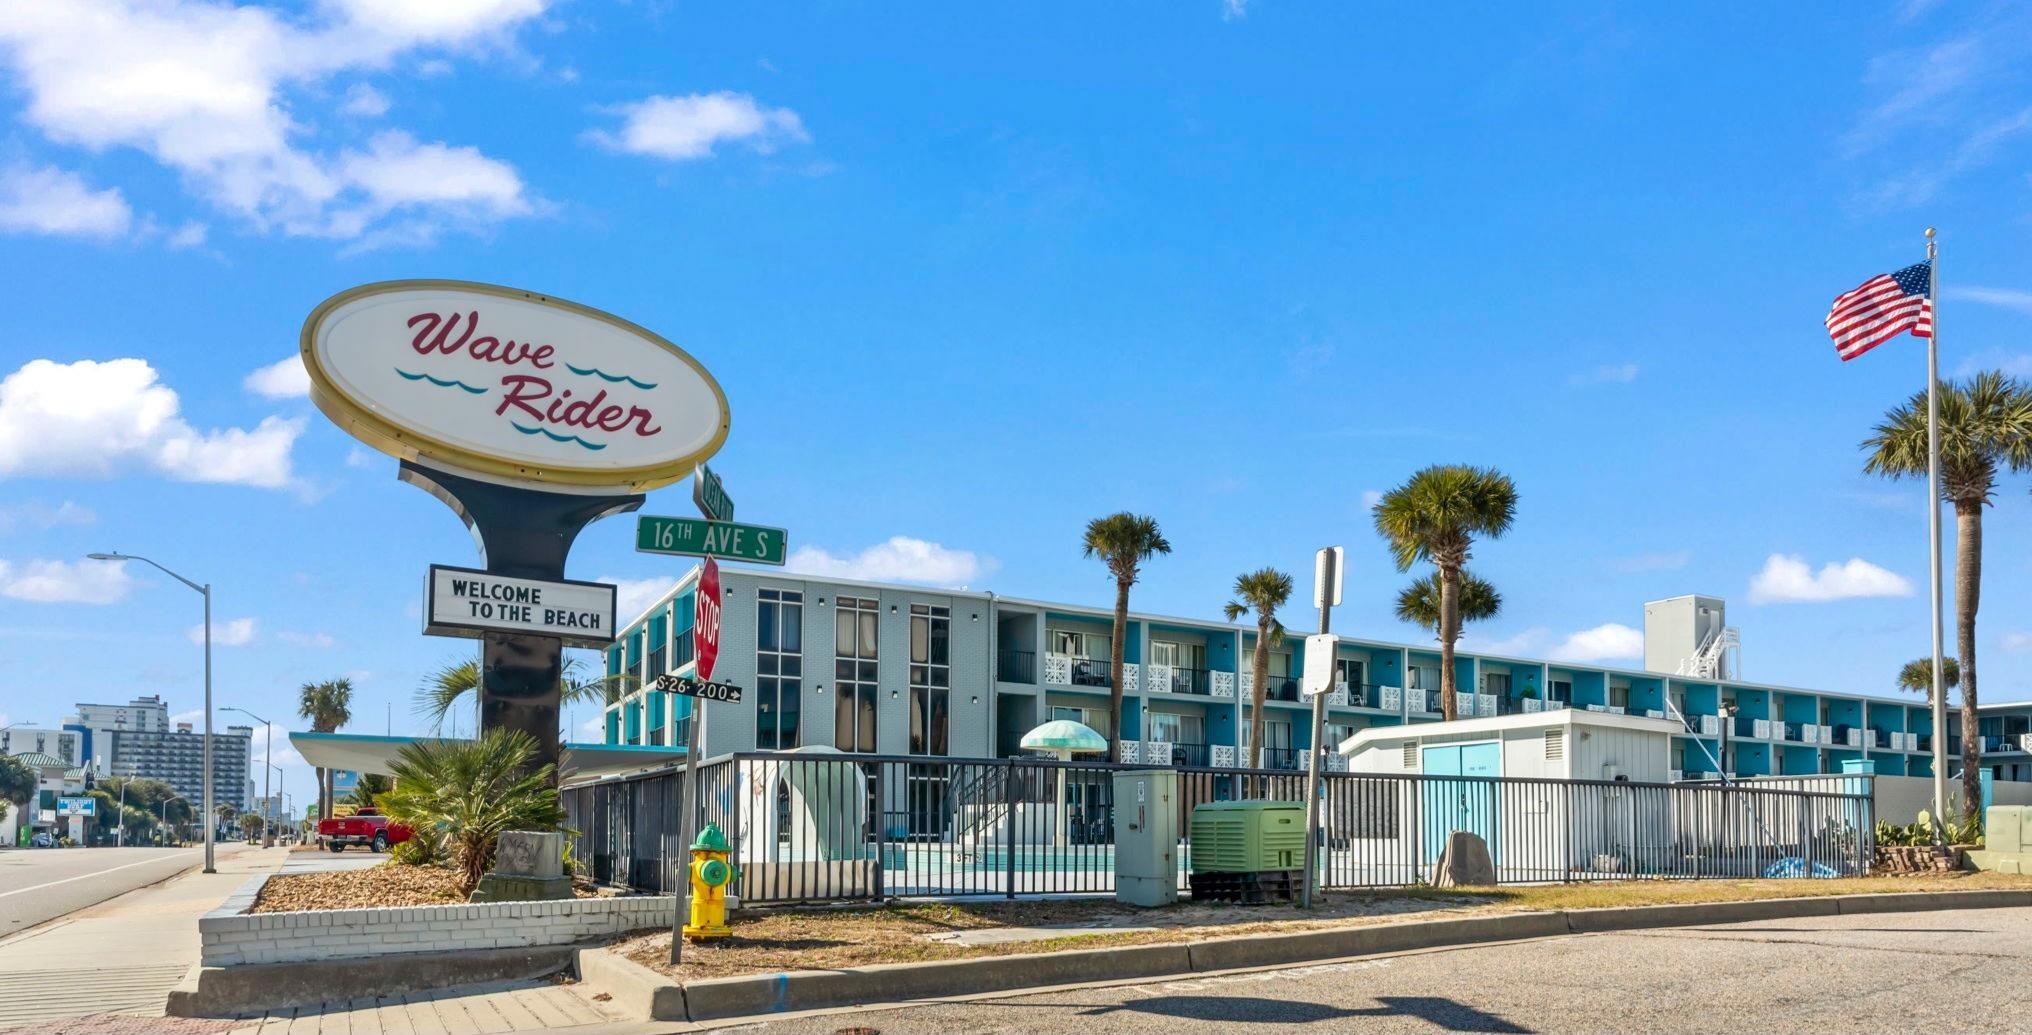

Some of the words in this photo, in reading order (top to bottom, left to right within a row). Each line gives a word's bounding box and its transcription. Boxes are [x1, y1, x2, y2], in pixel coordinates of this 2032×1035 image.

[407, 311, 556, 369] Wave
[495, 374, 662, 437] Rider
[654, 521, 692, 548] 16TH
[703, 525, 745, 555] AVE
[756, 531, 769, 558] S
[452, 579, 542, 605] WELCOME
[469, 601, 493, 618] TO
[498, 603, 532, 622] THE
[544, 609, 600, 629] BEACH
[696, 591, 720, 645] STOP
[697, 683, 727, 700] 200
